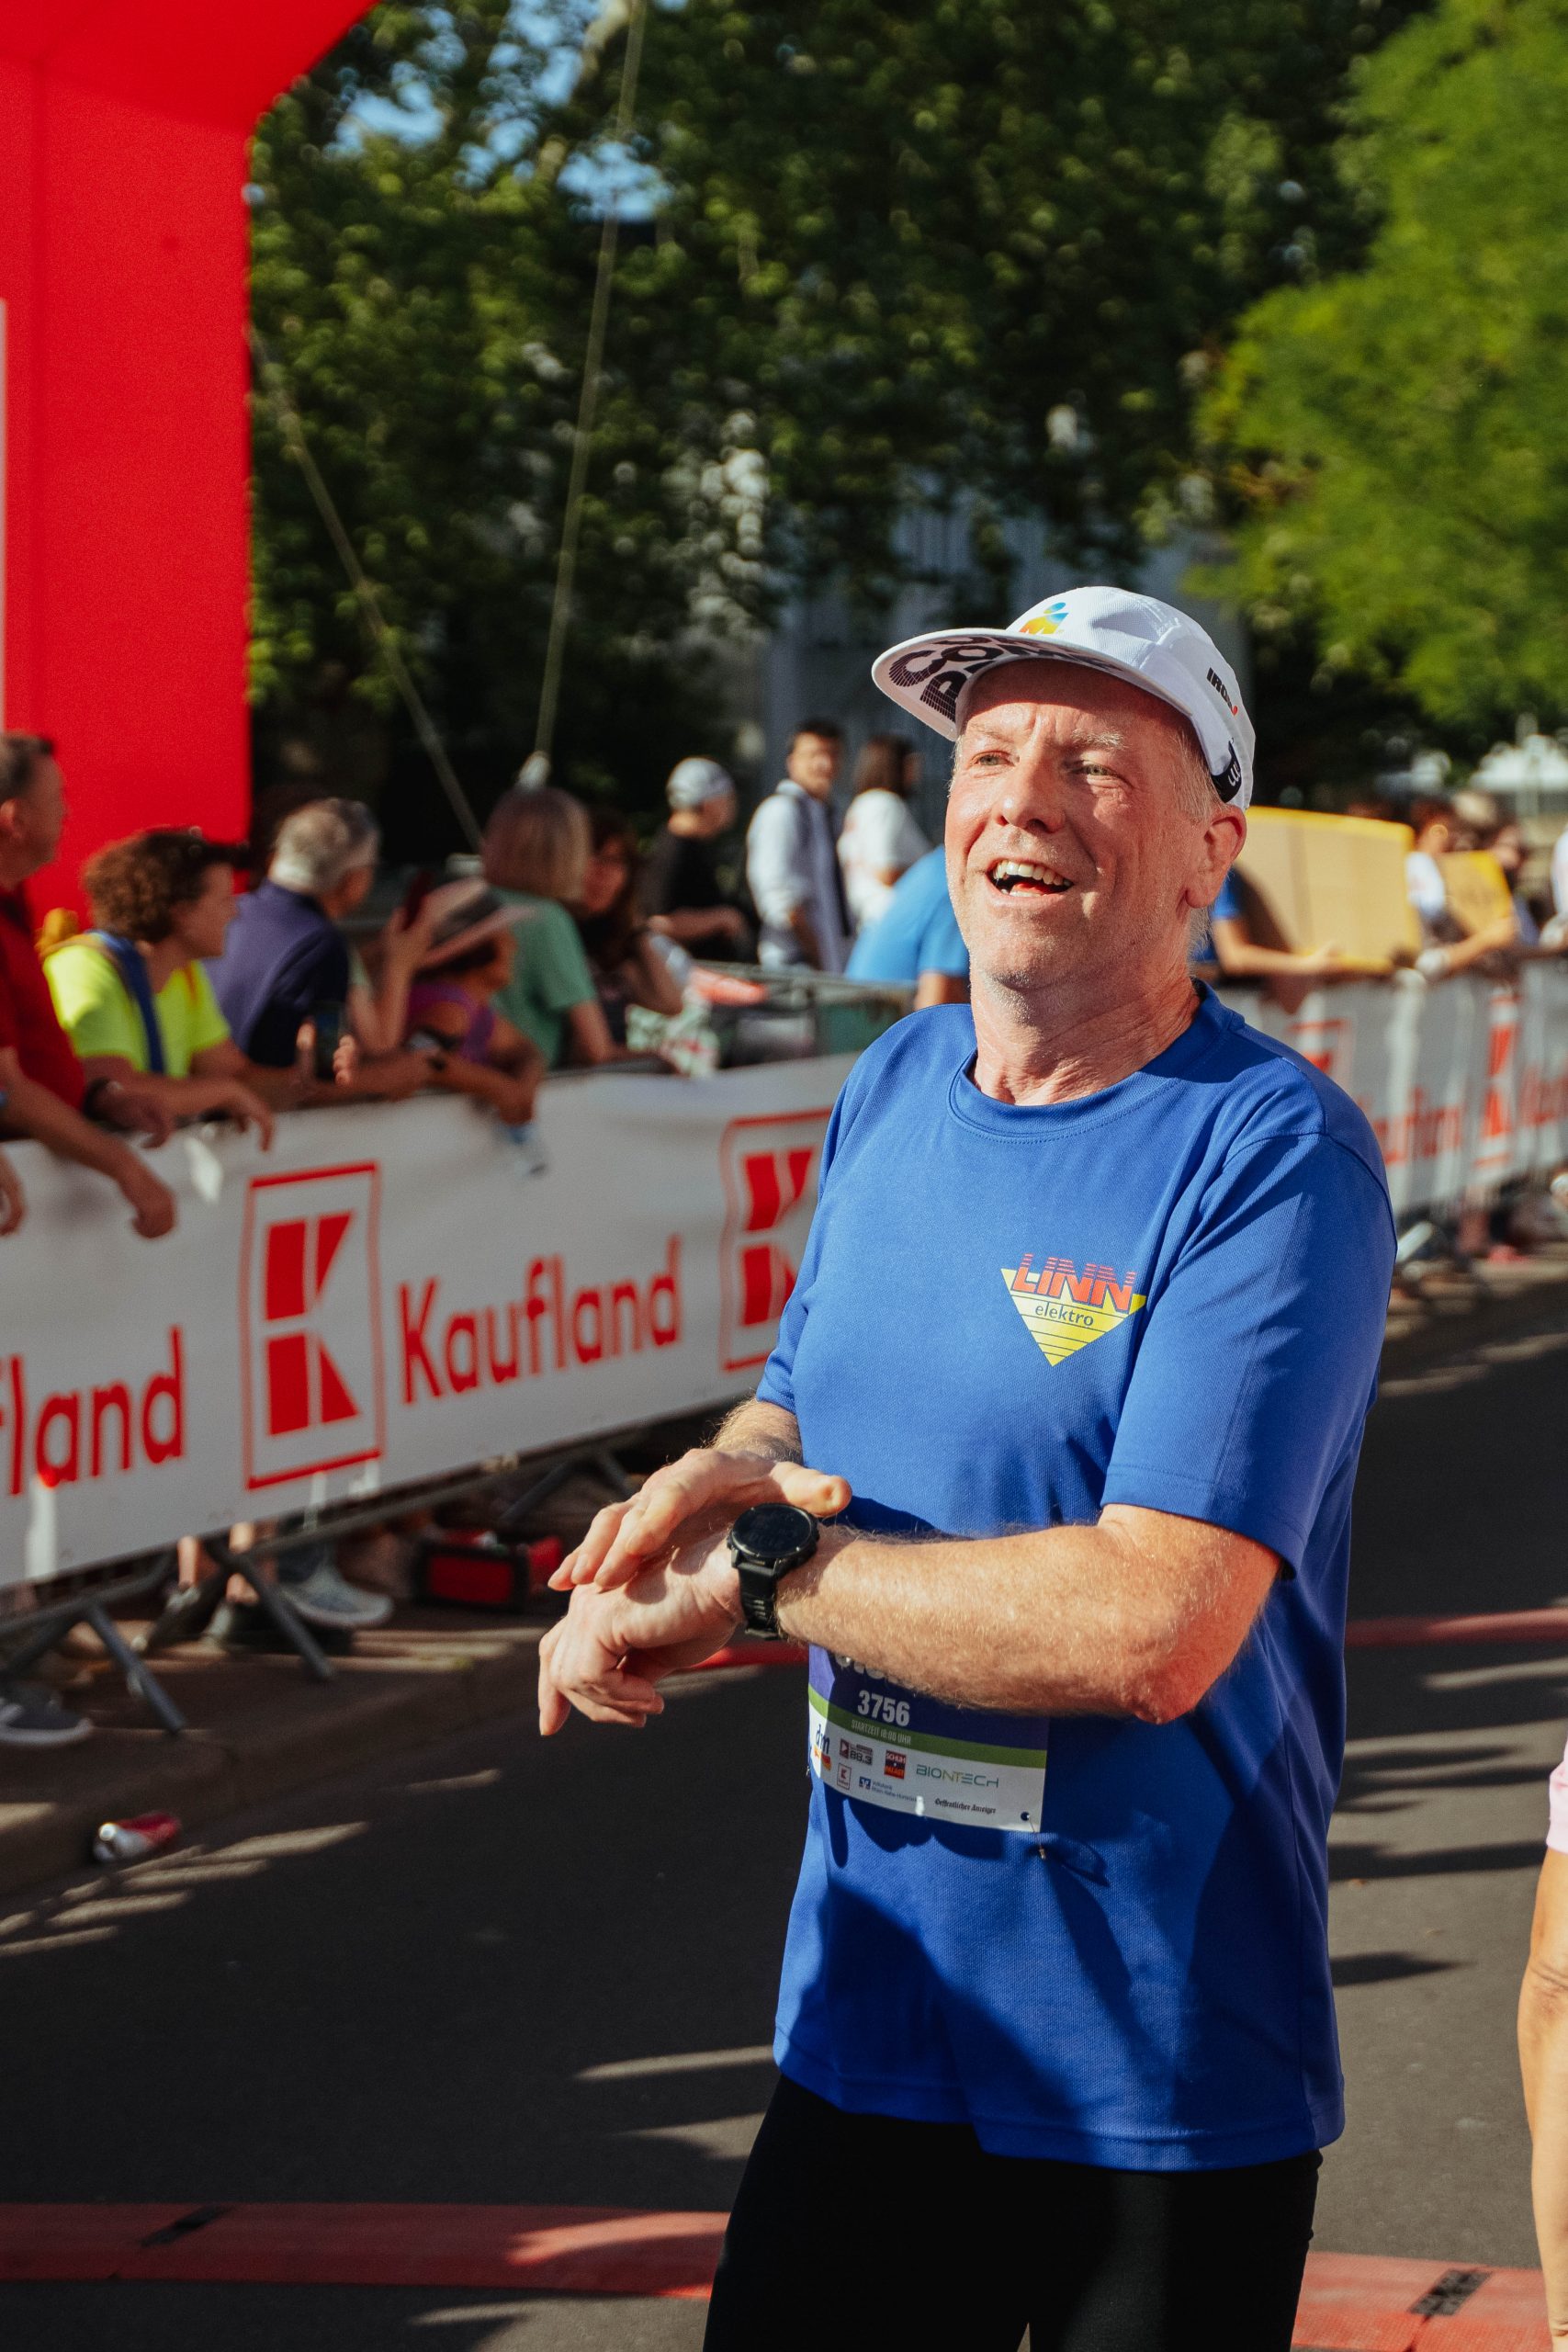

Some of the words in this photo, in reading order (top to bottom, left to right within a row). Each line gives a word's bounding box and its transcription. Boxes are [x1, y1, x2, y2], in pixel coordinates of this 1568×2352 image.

[1010, 1253, 1137, 1315] LINN
[398, 1234, 681, 1405] Kaufland
[1035, 1301, 1095, 1327] elektro
[0, 1323, 186, 1496] land
[857, 1690, 910, 1726] 3756
[897, 1734, 911, 1746] UHR
